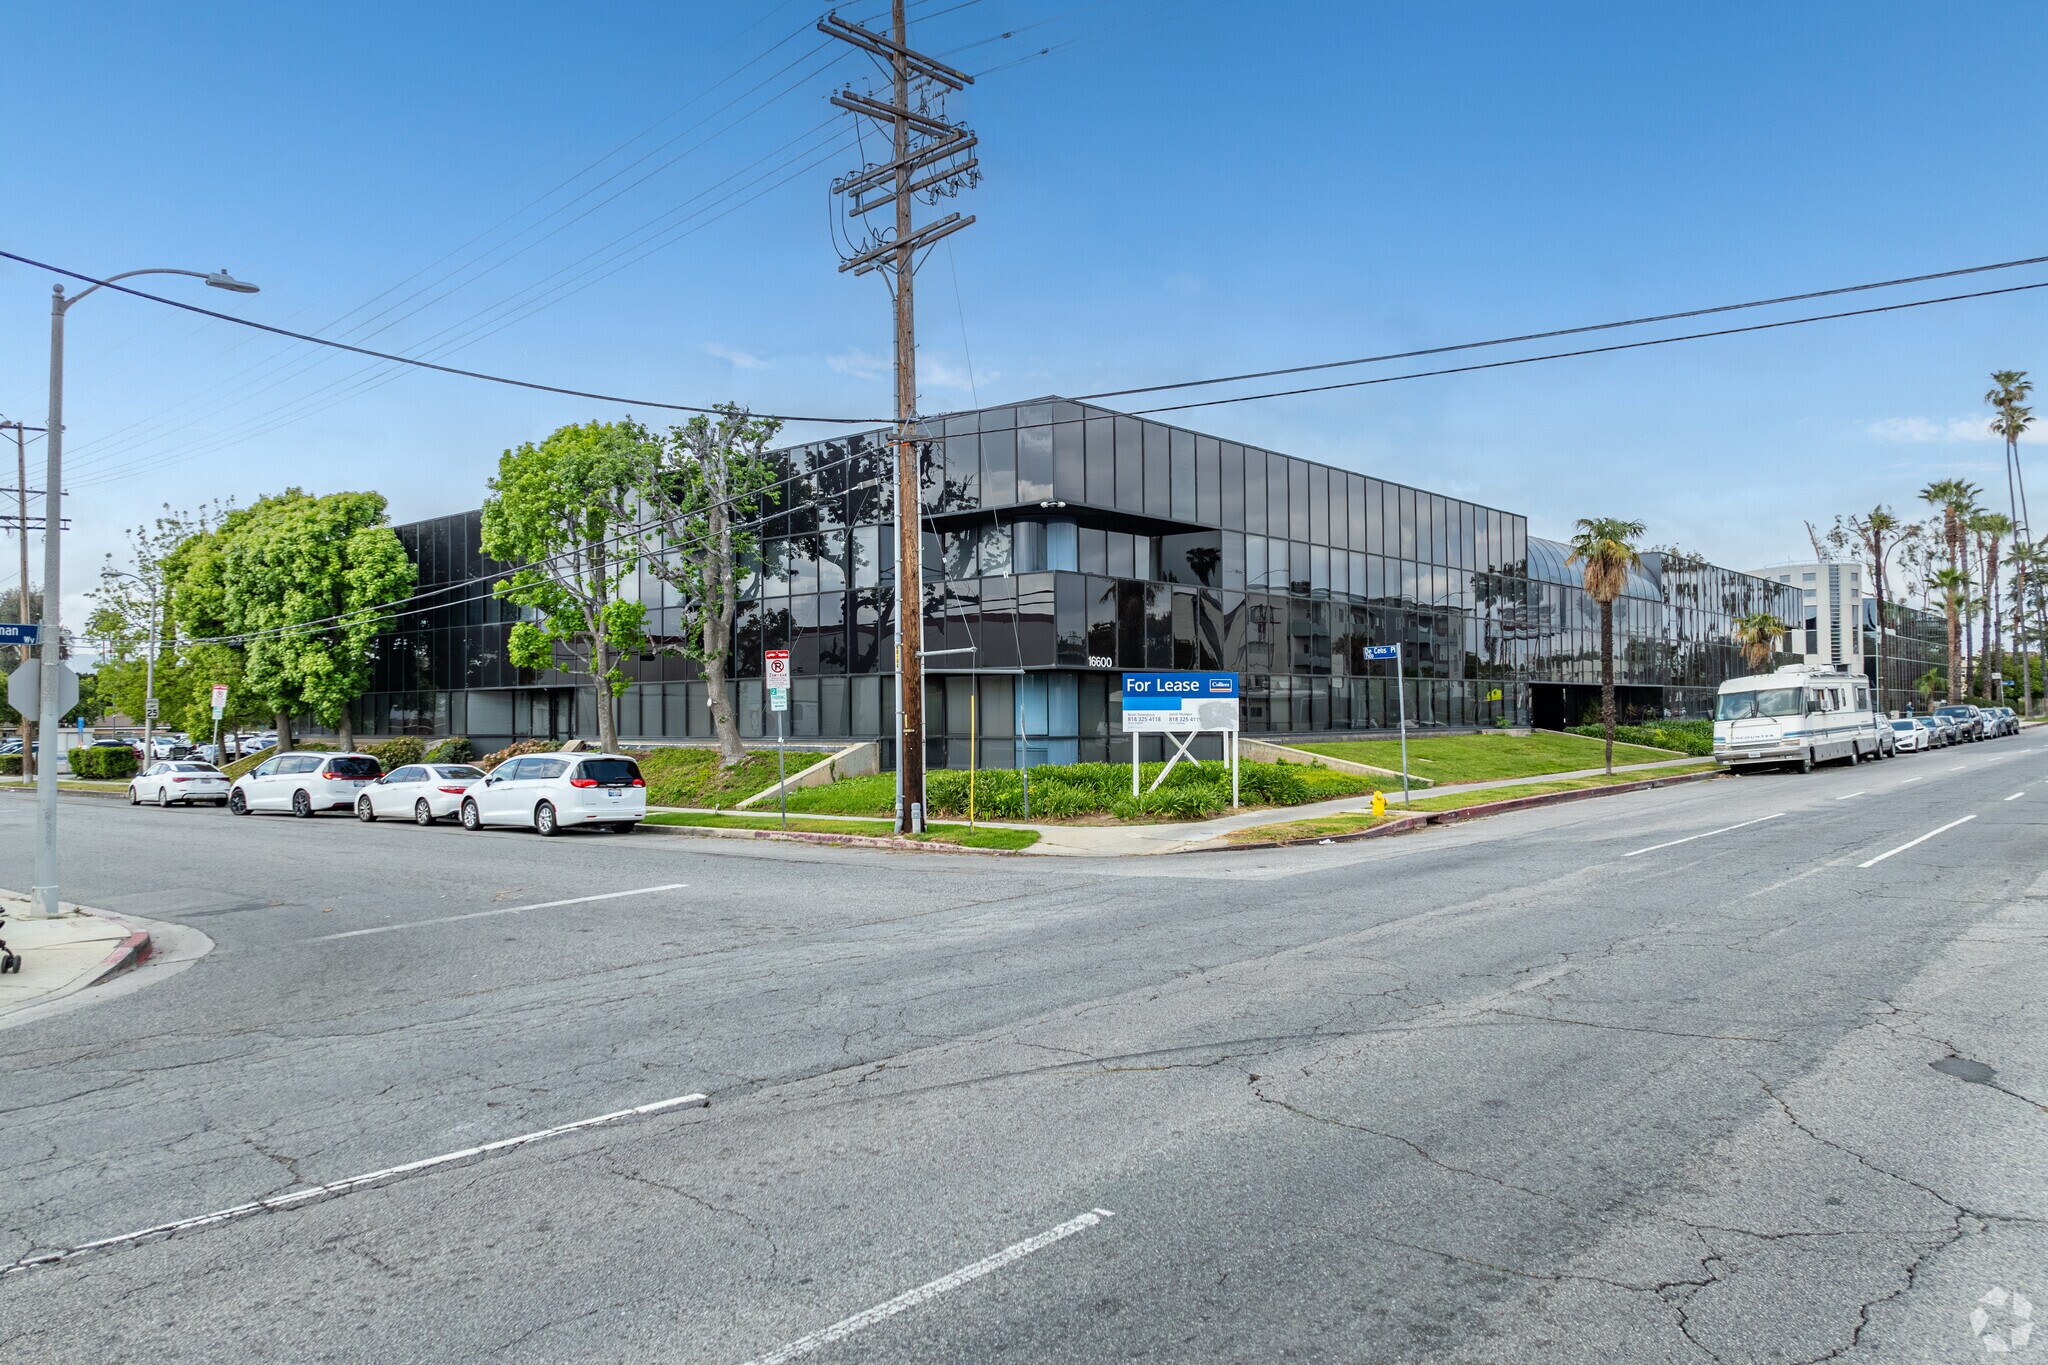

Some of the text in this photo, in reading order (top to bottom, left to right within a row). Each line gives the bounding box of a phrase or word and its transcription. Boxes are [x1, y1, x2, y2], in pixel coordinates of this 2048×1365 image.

[23, 636, 35, 644] Wy
[1088, 656, 1113, 668] 16600
[1127, 678, 1200, 692] For Lease
[147, 709, 157, 717] 25
